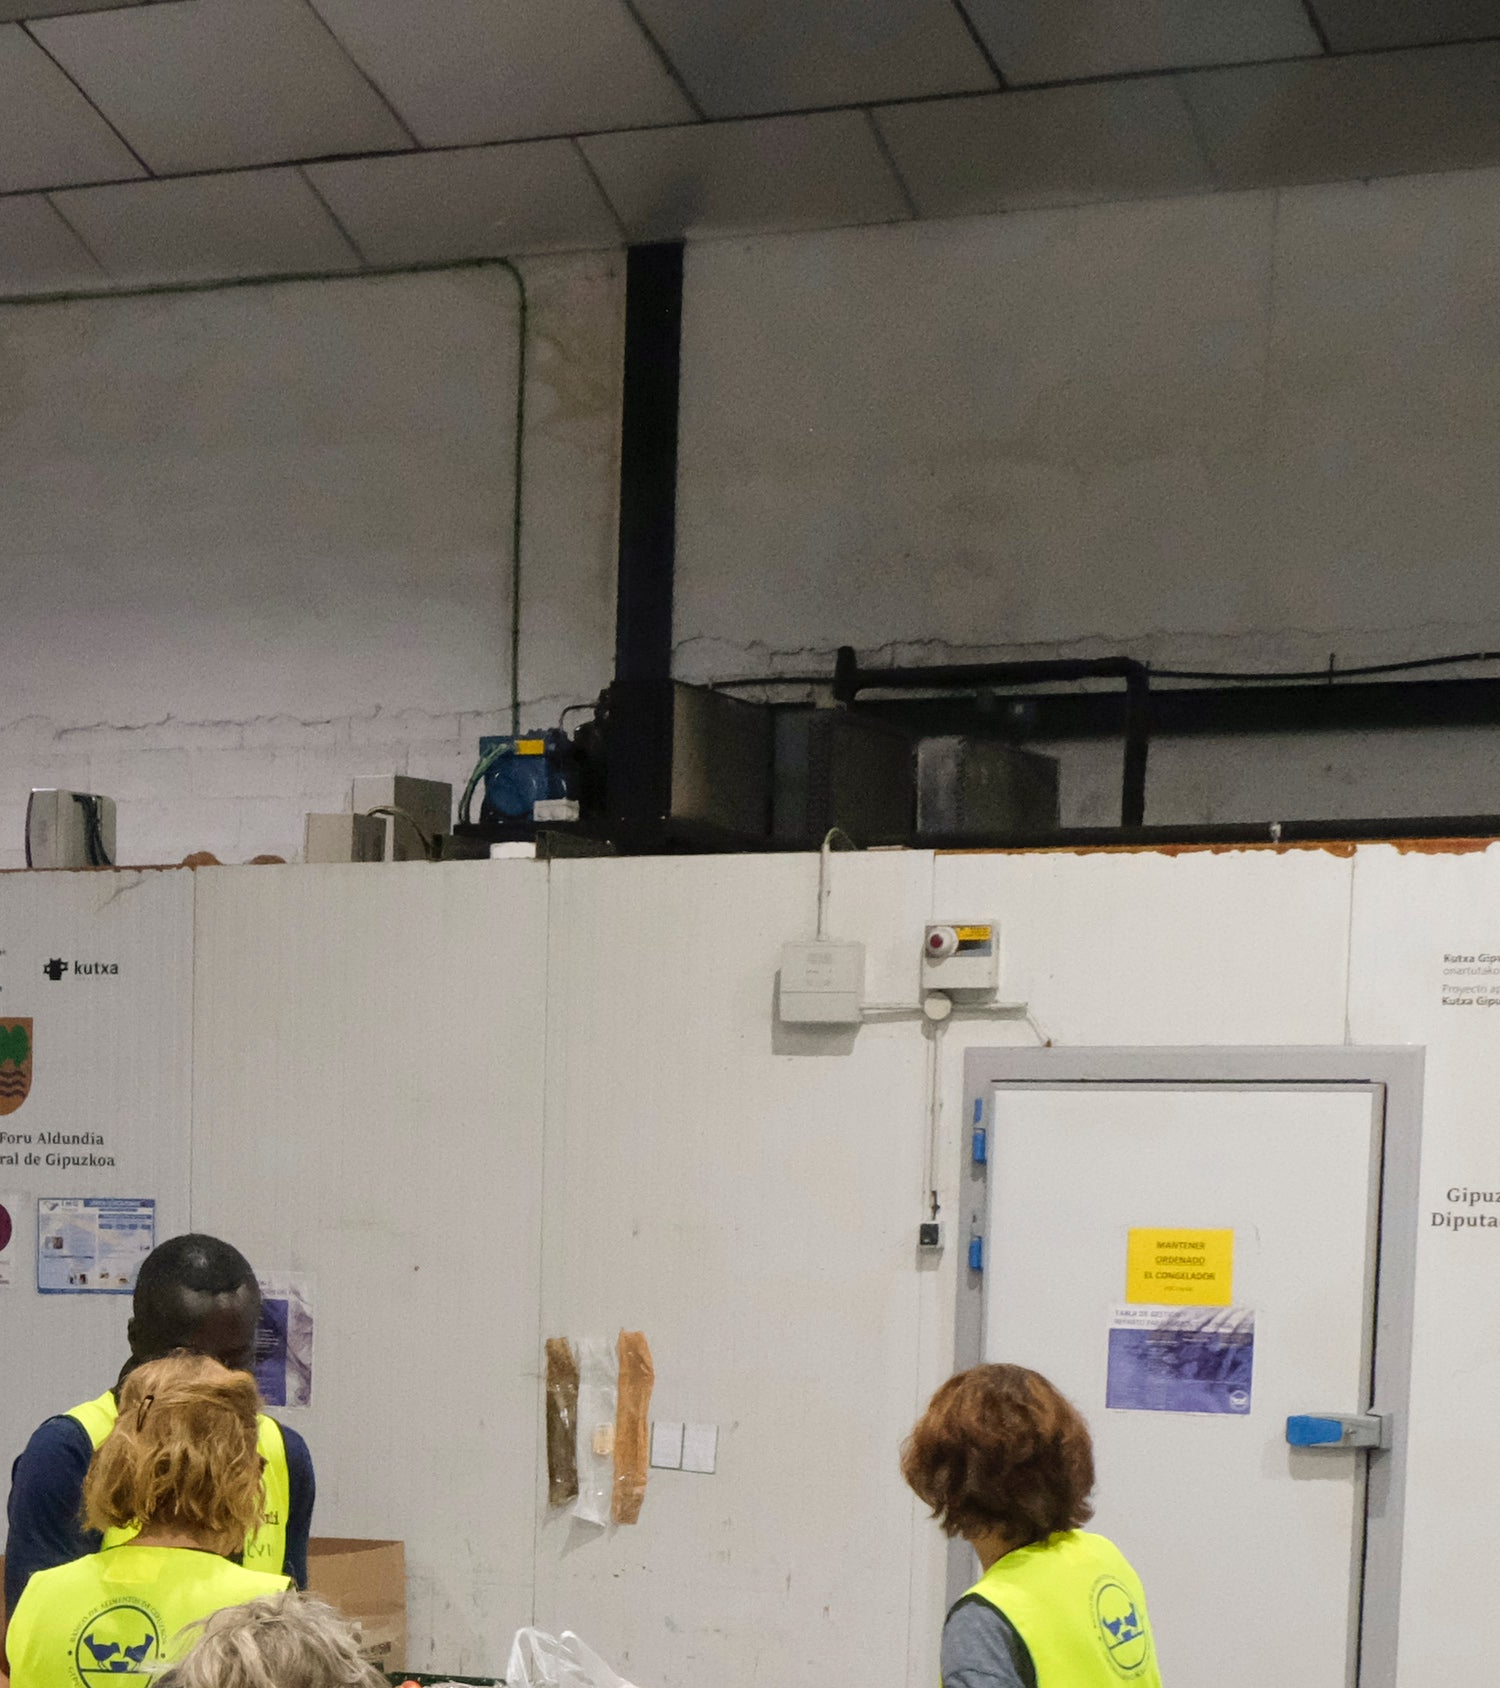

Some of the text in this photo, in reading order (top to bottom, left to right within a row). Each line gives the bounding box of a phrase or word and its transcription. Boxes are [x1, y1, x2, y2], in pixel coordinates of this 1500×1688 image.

[1443, 953, 1475, 963] Kutxa
[74, 960, 119, 975] kutxa
[1442, 984, 1488, 995] Proyecto
[1442, 996, 1474, 1006] Kutxa
[37, 1132, 104, 1145] Aldundia
[24, 1153, 41, 1166] de
[45, 1153, 116, 1169] Gipuzkoa
[1156, 1241, 1205, 1250] MANTENER
[1155, 1256, 1205, 1265] ORDENADO
[1155, 1271, 1215, 1280] CONGELADOR
